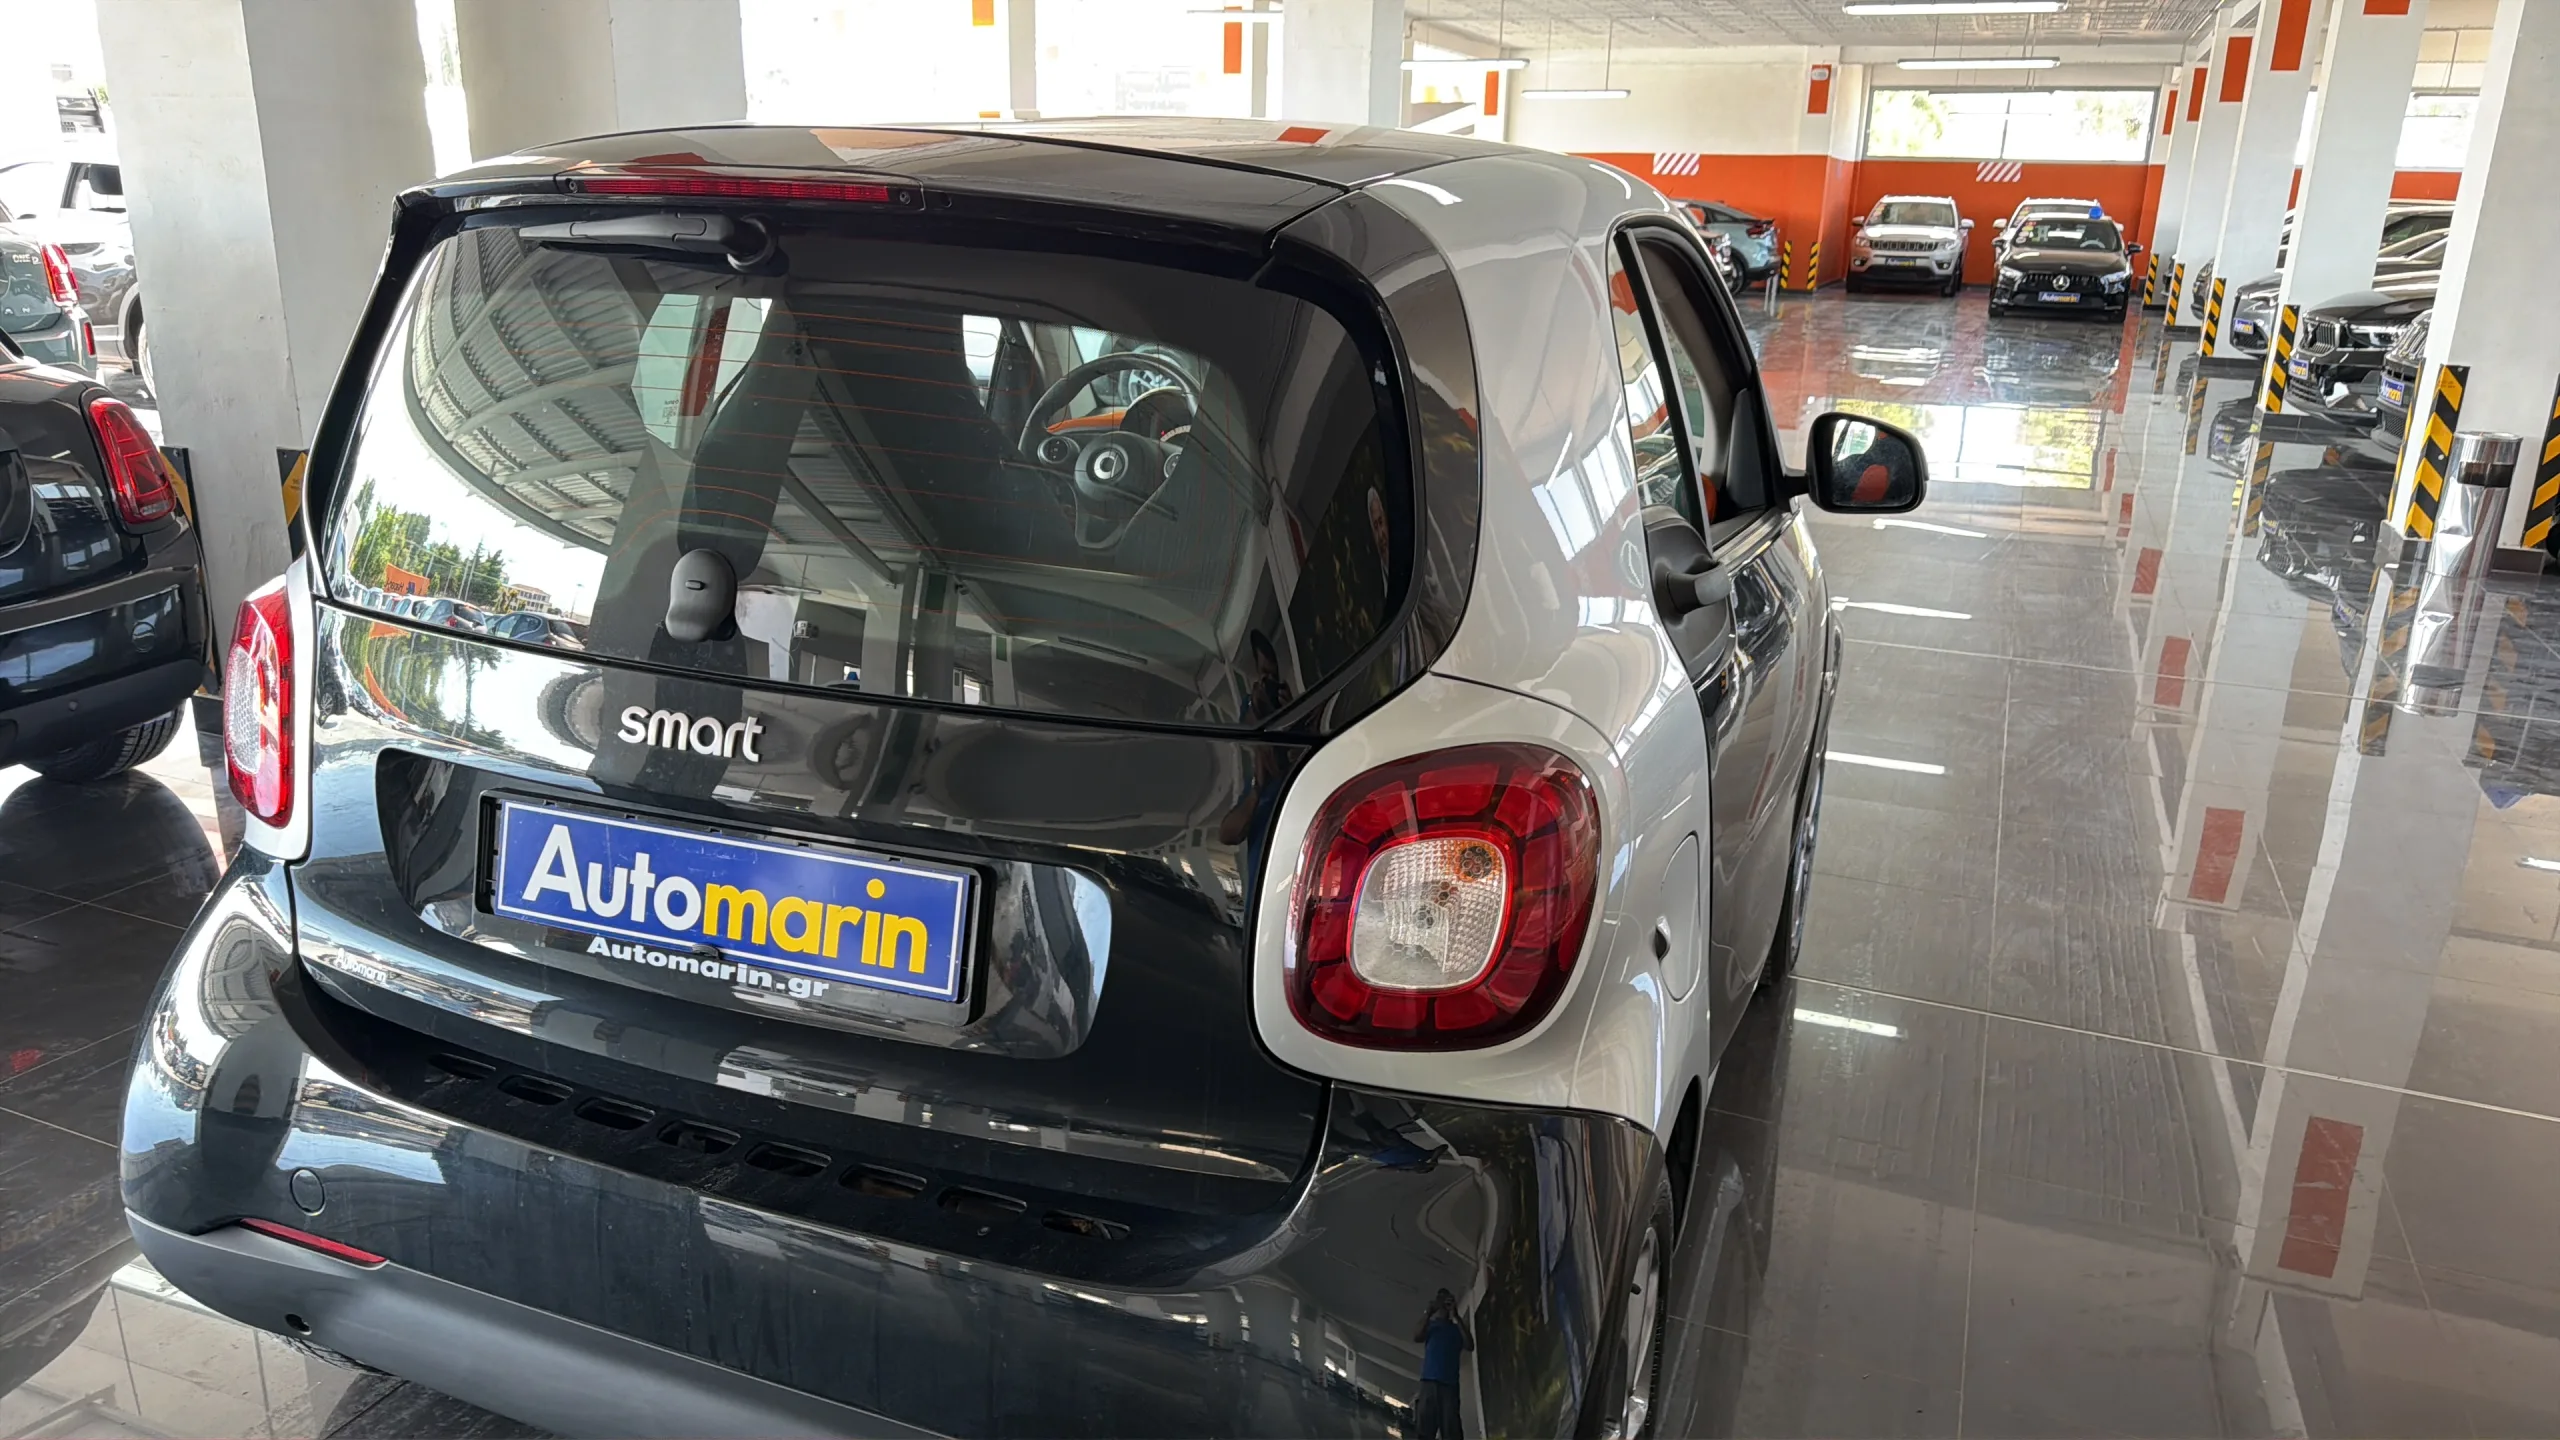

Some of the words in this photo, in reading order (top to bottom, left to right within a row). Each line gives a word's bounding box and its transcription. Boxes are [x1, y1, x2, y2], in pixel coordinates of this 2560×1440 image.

[617, 705, 765, 763] smart
[521, 824, 929, 974] Automarin
[587, 936, 830, 998] Automarin.gr
